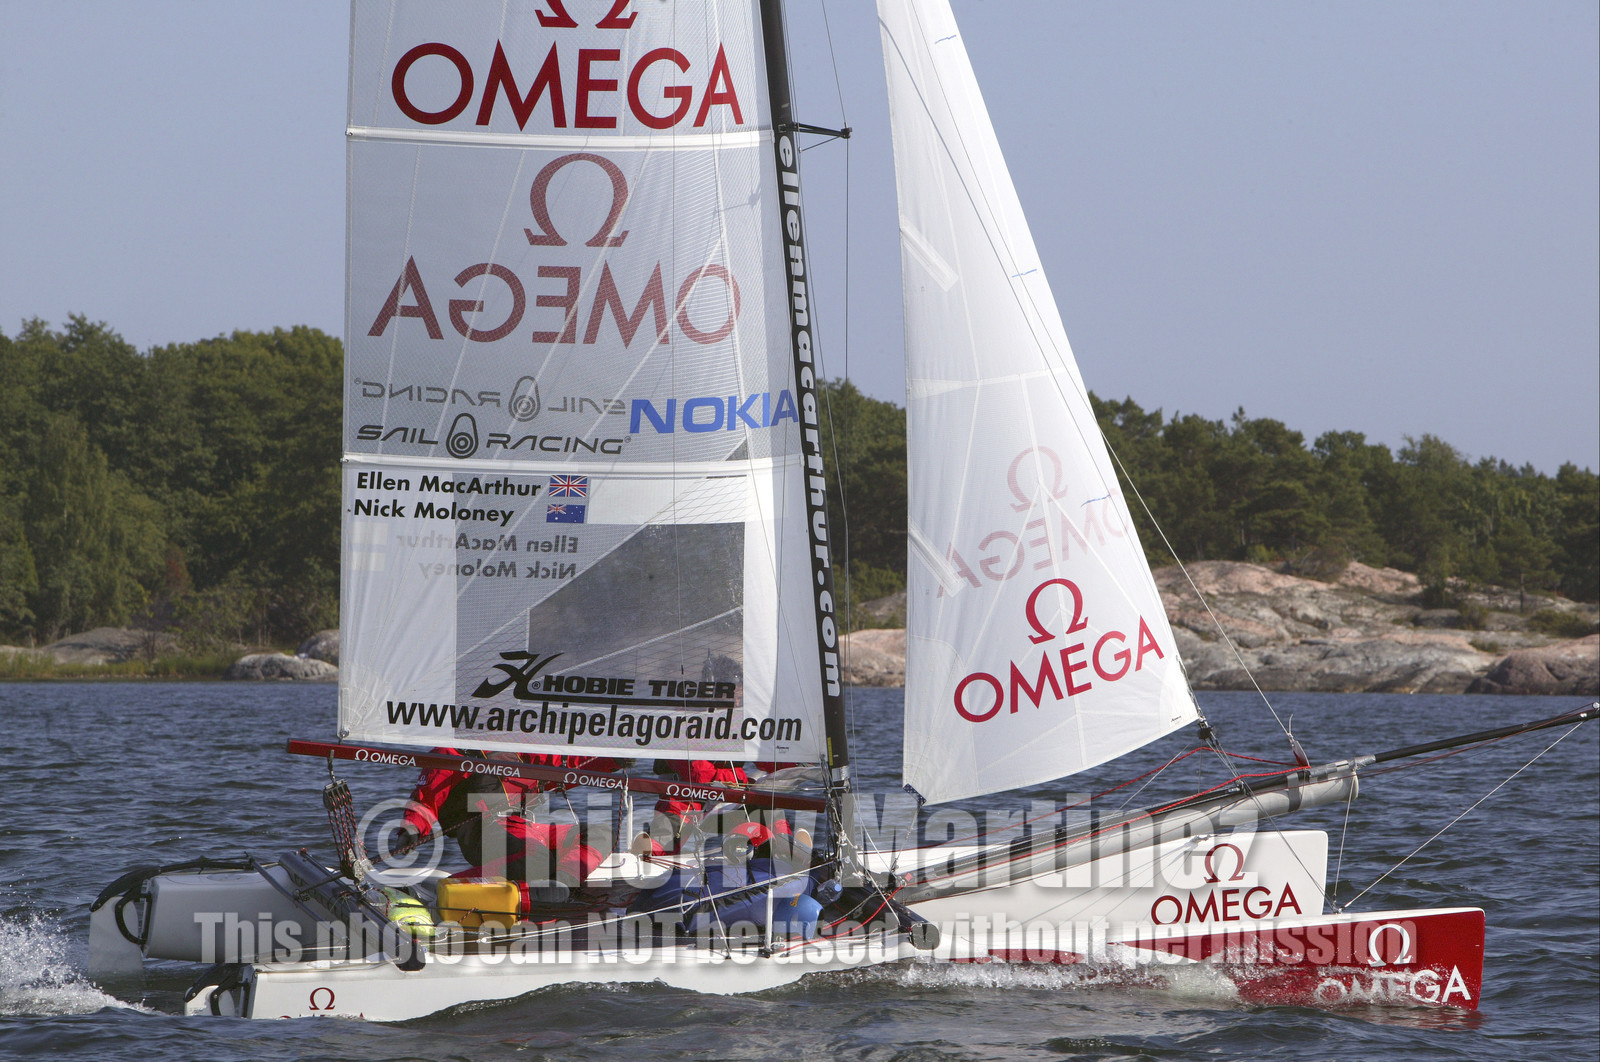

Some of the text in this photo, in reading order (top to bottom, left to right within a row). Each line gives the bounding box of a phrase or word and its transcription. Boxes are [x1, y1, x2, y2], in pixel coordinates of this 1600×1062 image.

[391, 39, 744, 131] OMEGA
[629, 389, 799, 434] NOKIA
[778, 134, 841, 698] ellenmacarthur.com
[356, 424, 624, 455] SAIL RACING
[356, 471, 542, 497] Ellen MacArthur
[353, 498, 515, 527] Nick Moloney
[953, 614, 1165, 723] OMEGA
[543, 674, 737, 699] HOBIE TIGER
[386, 699, 802, 747] www.archipelagoraid.com
[370, 751, 417, 767] OMEGA
[475, 762, 521, 778] OMEGA
[579, 774, 624, 790] OMEGA
[680, 787, 726, 802] OMEGA
[1151, 882, 1302, 926] OMEGA
[1314, 963, 1472, 1004] OMEGA
